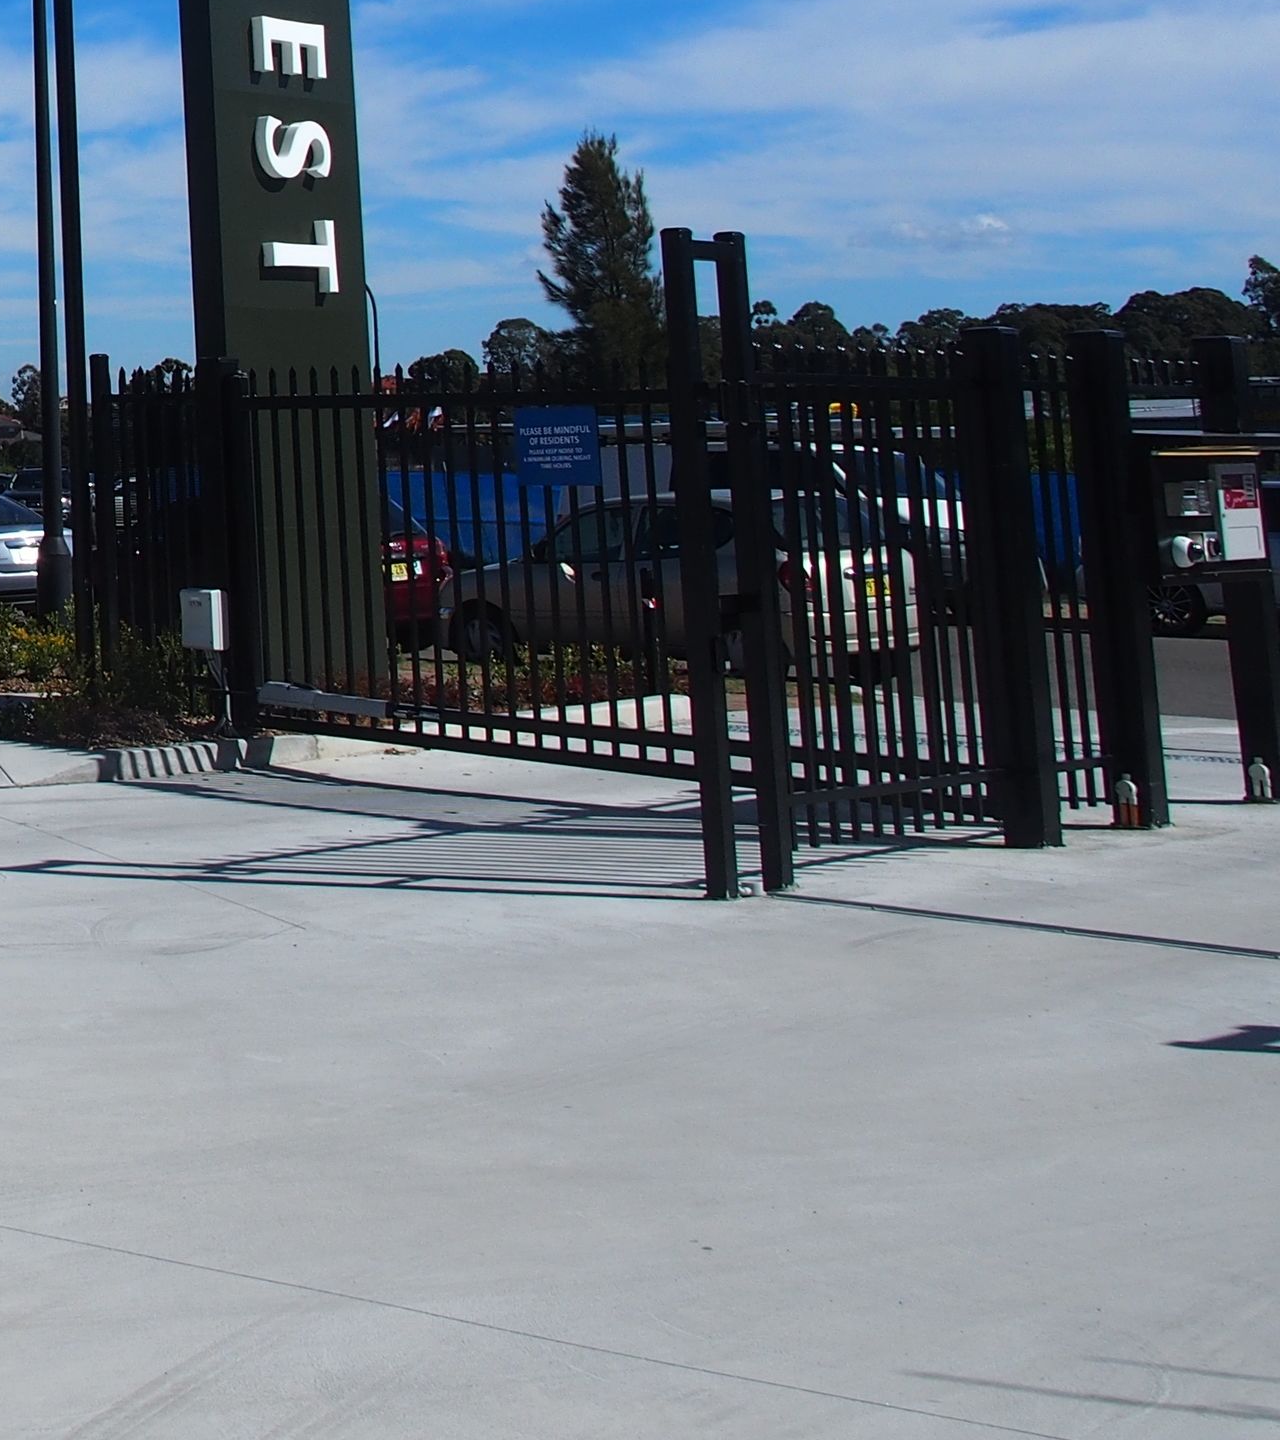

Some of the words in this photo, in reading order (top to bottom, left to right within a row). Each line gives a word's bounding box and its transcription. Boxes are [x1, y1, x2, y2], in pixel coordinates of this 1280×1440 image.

[520, 426, 542, 436] PLEASE
[543, 426, 552, 435] BE
[553, 425, 591, 434] MINDFUL
[529, 437, 538, 445] OF
[540, 435, 580, 445] RESIDENTS
